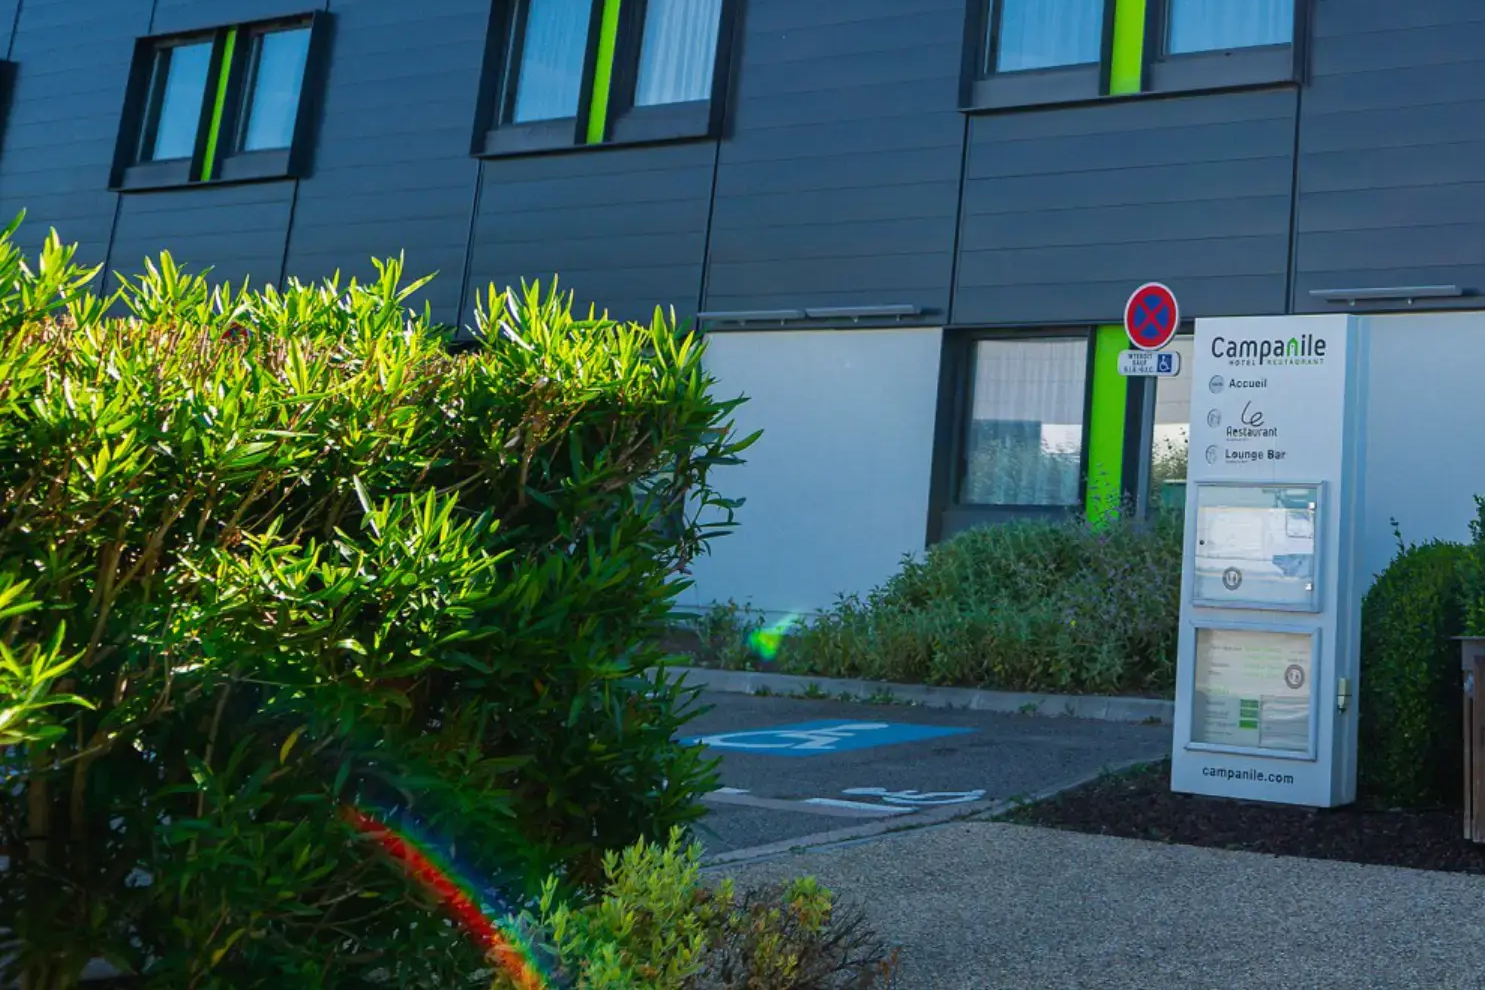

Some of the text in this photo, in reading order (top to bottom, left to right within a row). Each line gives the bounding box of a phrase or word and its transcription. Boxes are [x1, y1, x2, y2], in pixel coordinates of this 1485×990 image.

[1211, 334, 1326, 365] Campanile
[1229, 378, 1267, 388] Accueil
[1226, 426, 1278, 437] Restaurant
[1225, 449, 1286, 461] Lounge Bar
[1202, 767, 1294, 784] campanile.com
